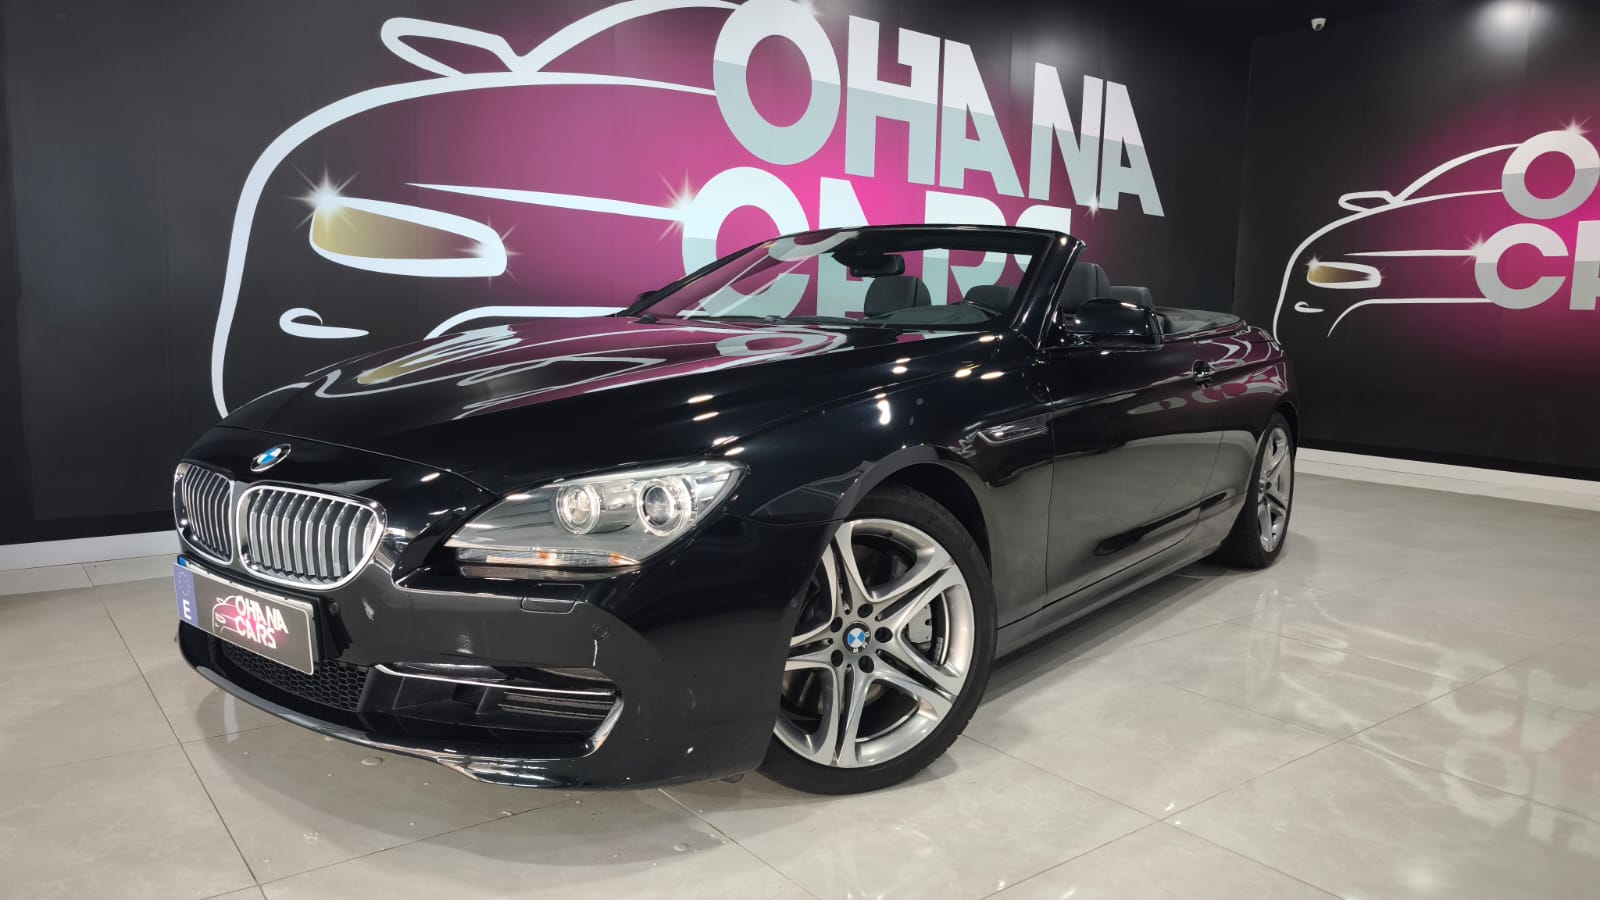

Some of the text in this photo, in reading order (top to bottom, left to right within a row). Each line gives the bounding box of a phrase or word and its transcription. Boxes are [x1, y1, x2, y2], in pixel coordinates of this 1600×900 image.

[713, 0, 1165, 217] OHANA
[182, 598, 192, 621] E
[235, 595, 289, 634] OHANA
[235, 615, 277, 649] CARS
